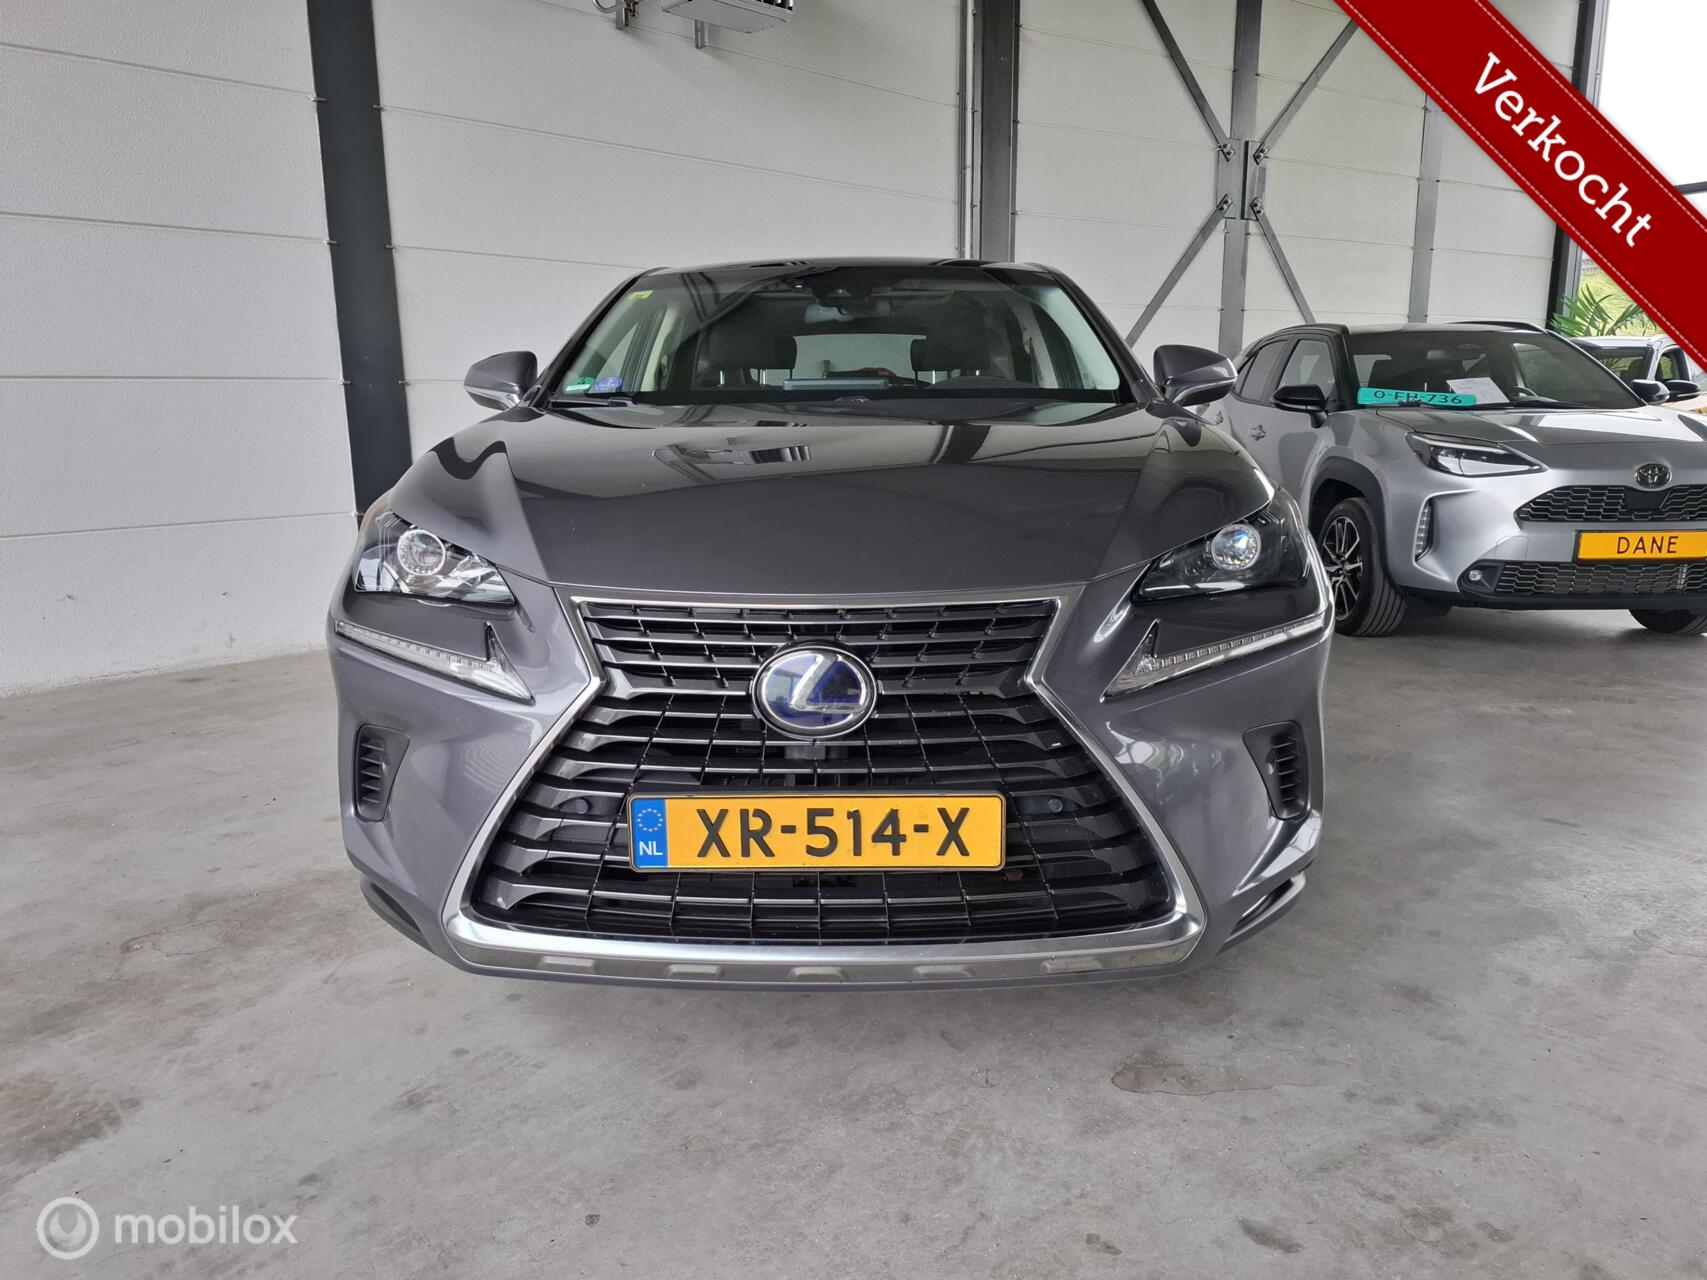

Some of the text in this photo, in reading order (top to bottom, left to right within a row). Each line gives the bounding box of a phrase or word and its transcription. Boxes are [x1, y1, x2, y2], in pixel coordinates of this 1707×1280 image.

[1616, 536, 1679, 554] DANE
[696, 807, 970, 858] XR-514-X
[639, 840, 664, 856] NL
